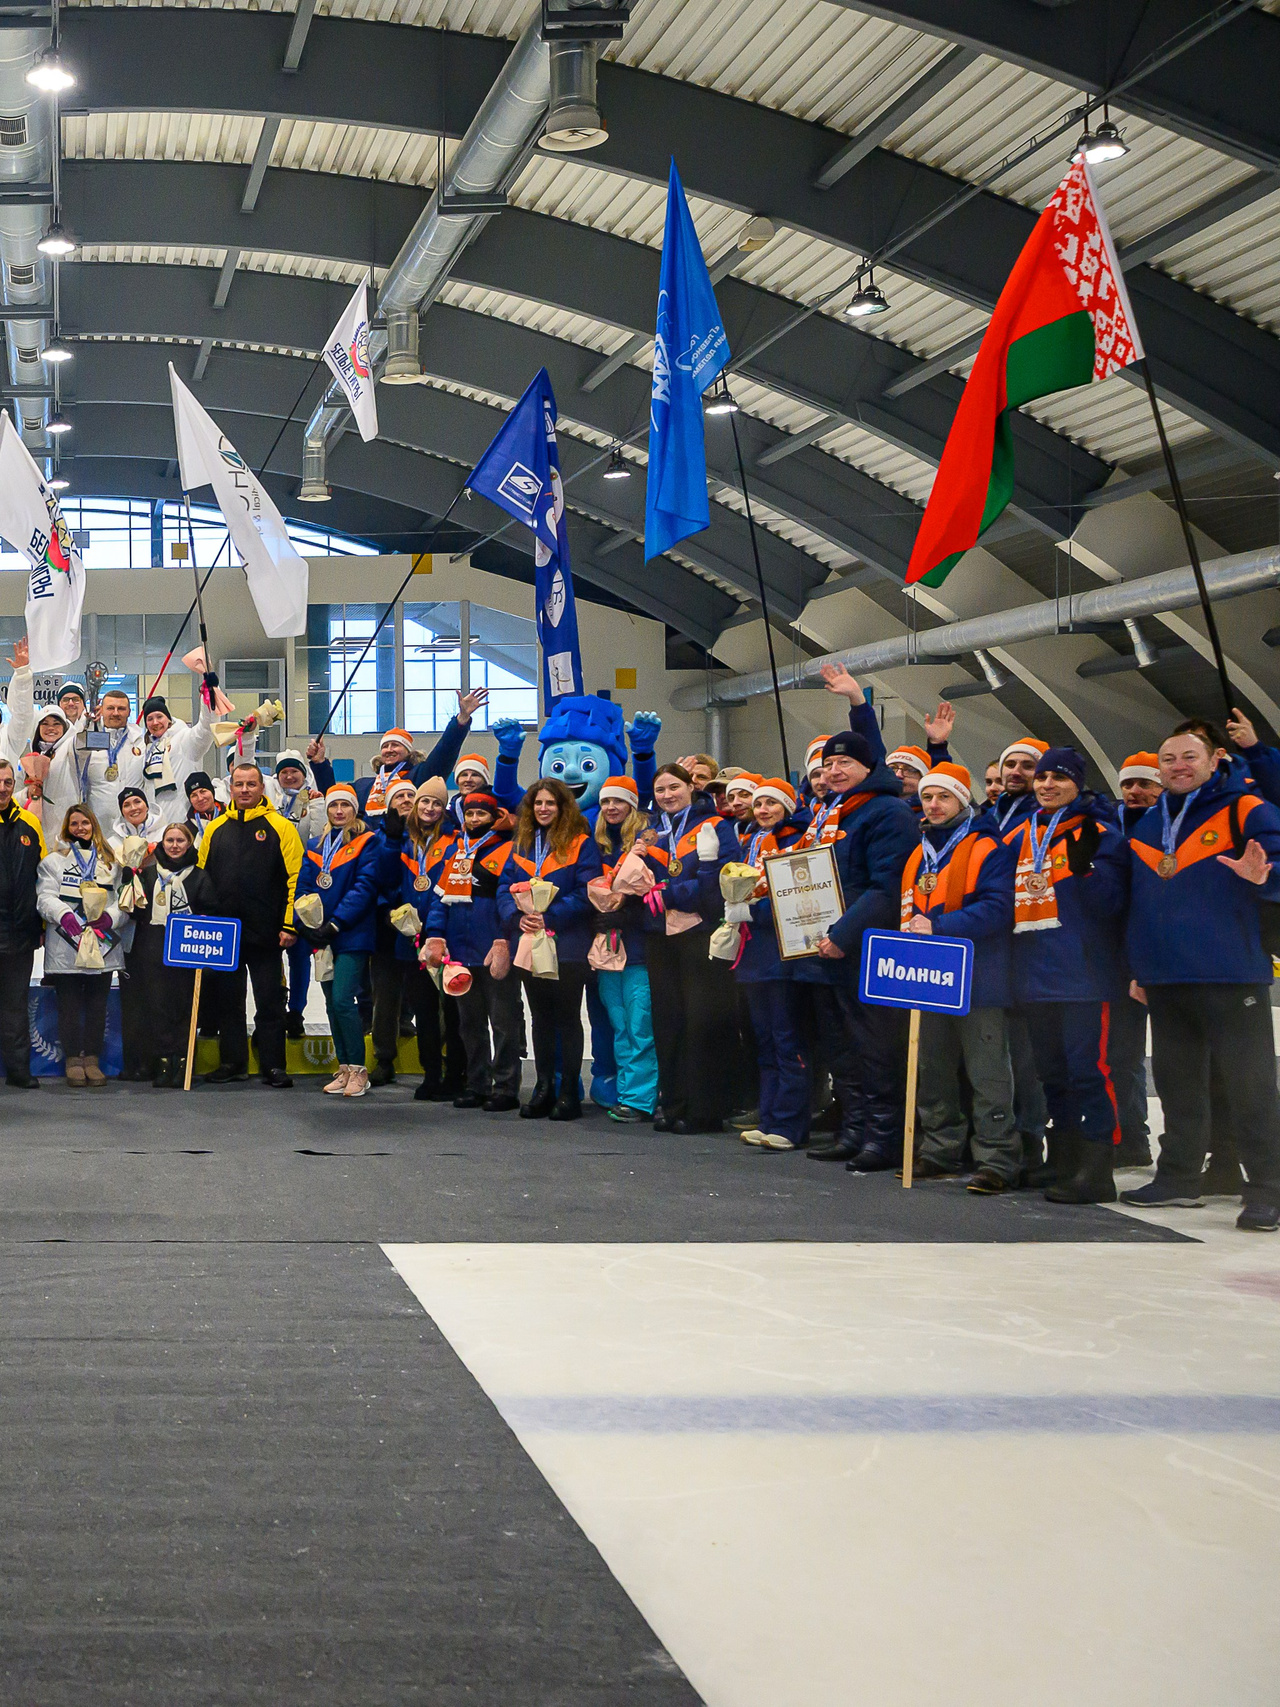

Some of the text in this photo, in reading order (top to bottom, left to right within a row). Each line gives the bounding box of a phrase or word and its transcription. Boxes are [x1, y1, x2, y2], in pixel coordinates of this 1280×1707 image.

[30, 527, 50, 556] БЕЛ
[36, 679, 59, 687] АФЕ
[776, 880, 833, 897] СЕРТИФИКАТ
[183, 925, 223, 941] Белые
[180, 942, 224, 958] тигры
[877, 957, 954, 987] Молния
